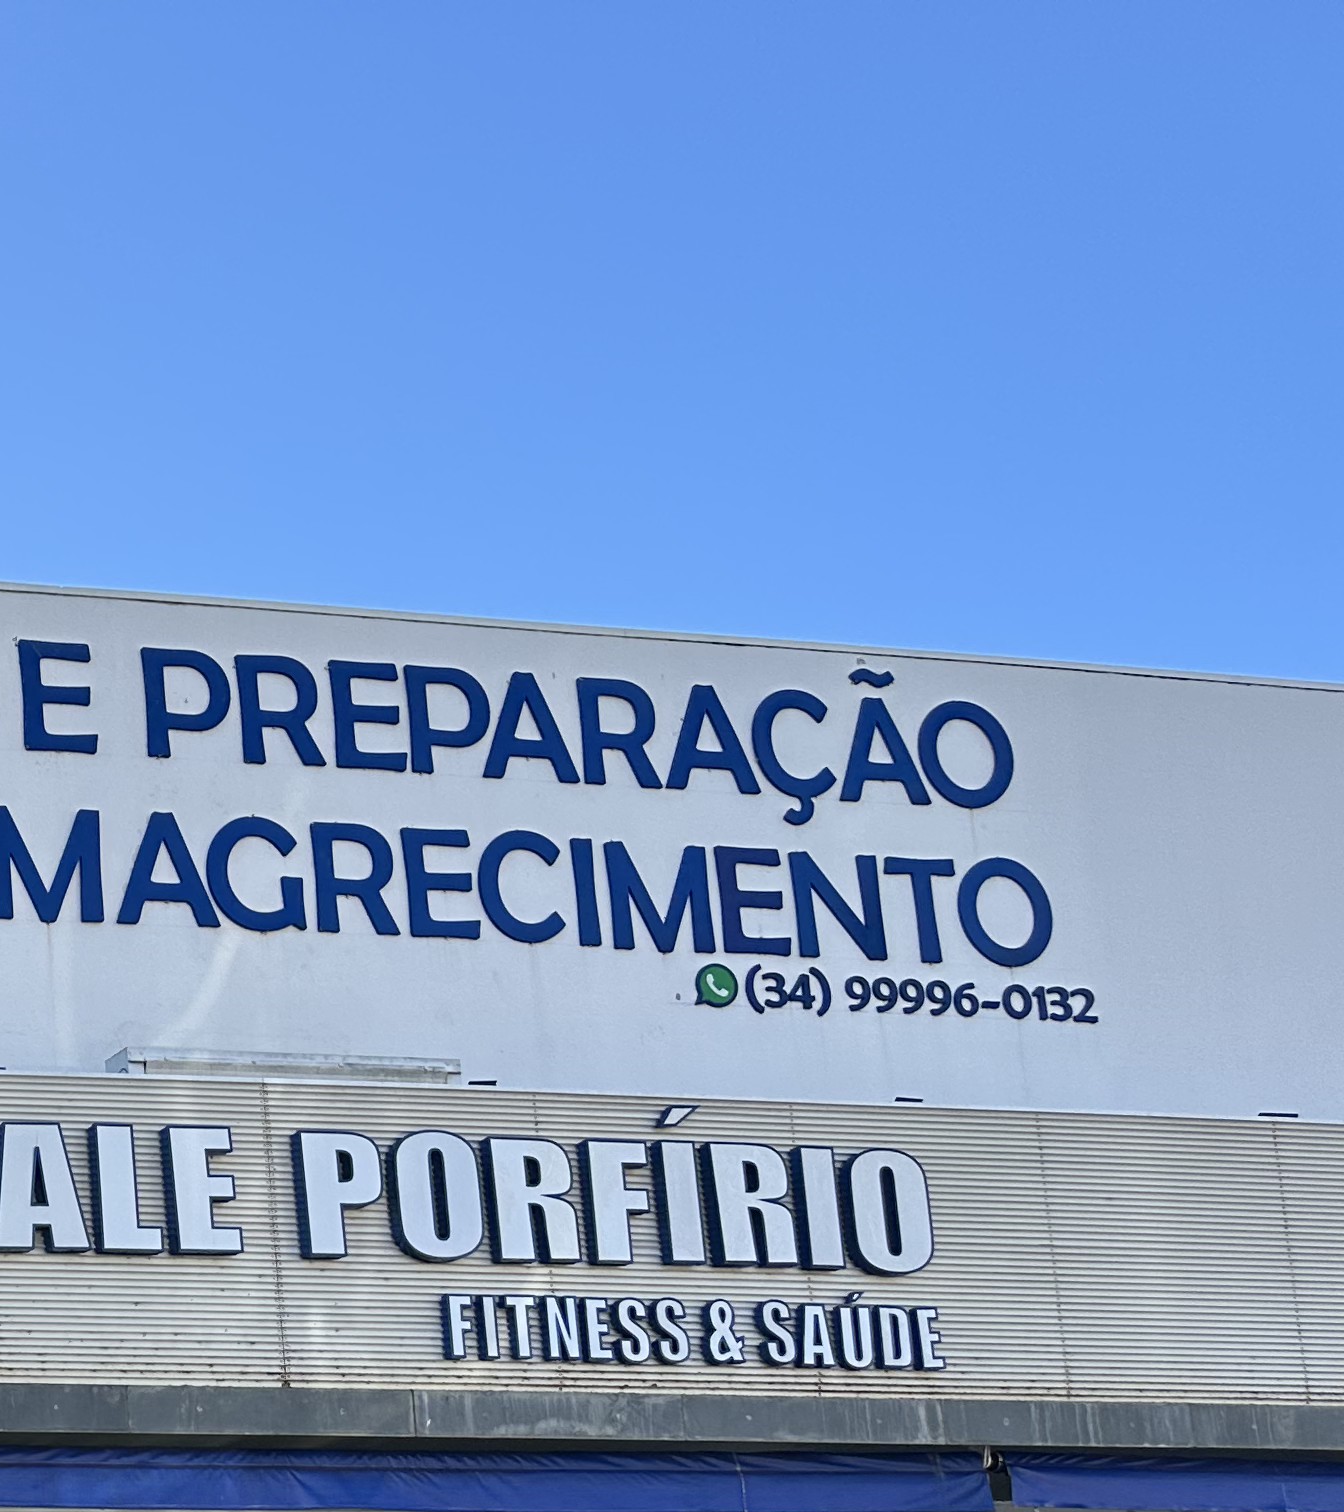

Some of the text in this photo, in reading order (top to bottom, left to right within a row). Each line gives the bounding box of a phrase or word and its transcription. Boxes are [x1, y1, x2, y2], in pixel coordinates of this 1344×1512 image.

[140, 647, 1015, 826] PREPARAÇÃO
[744, 964, 1100, 1024] (34) 99996-0132
[291, 1104, 935, 1278] PORFÍRIO
[443, 1291, 948, 1371] FITNESS & SAÚDE
